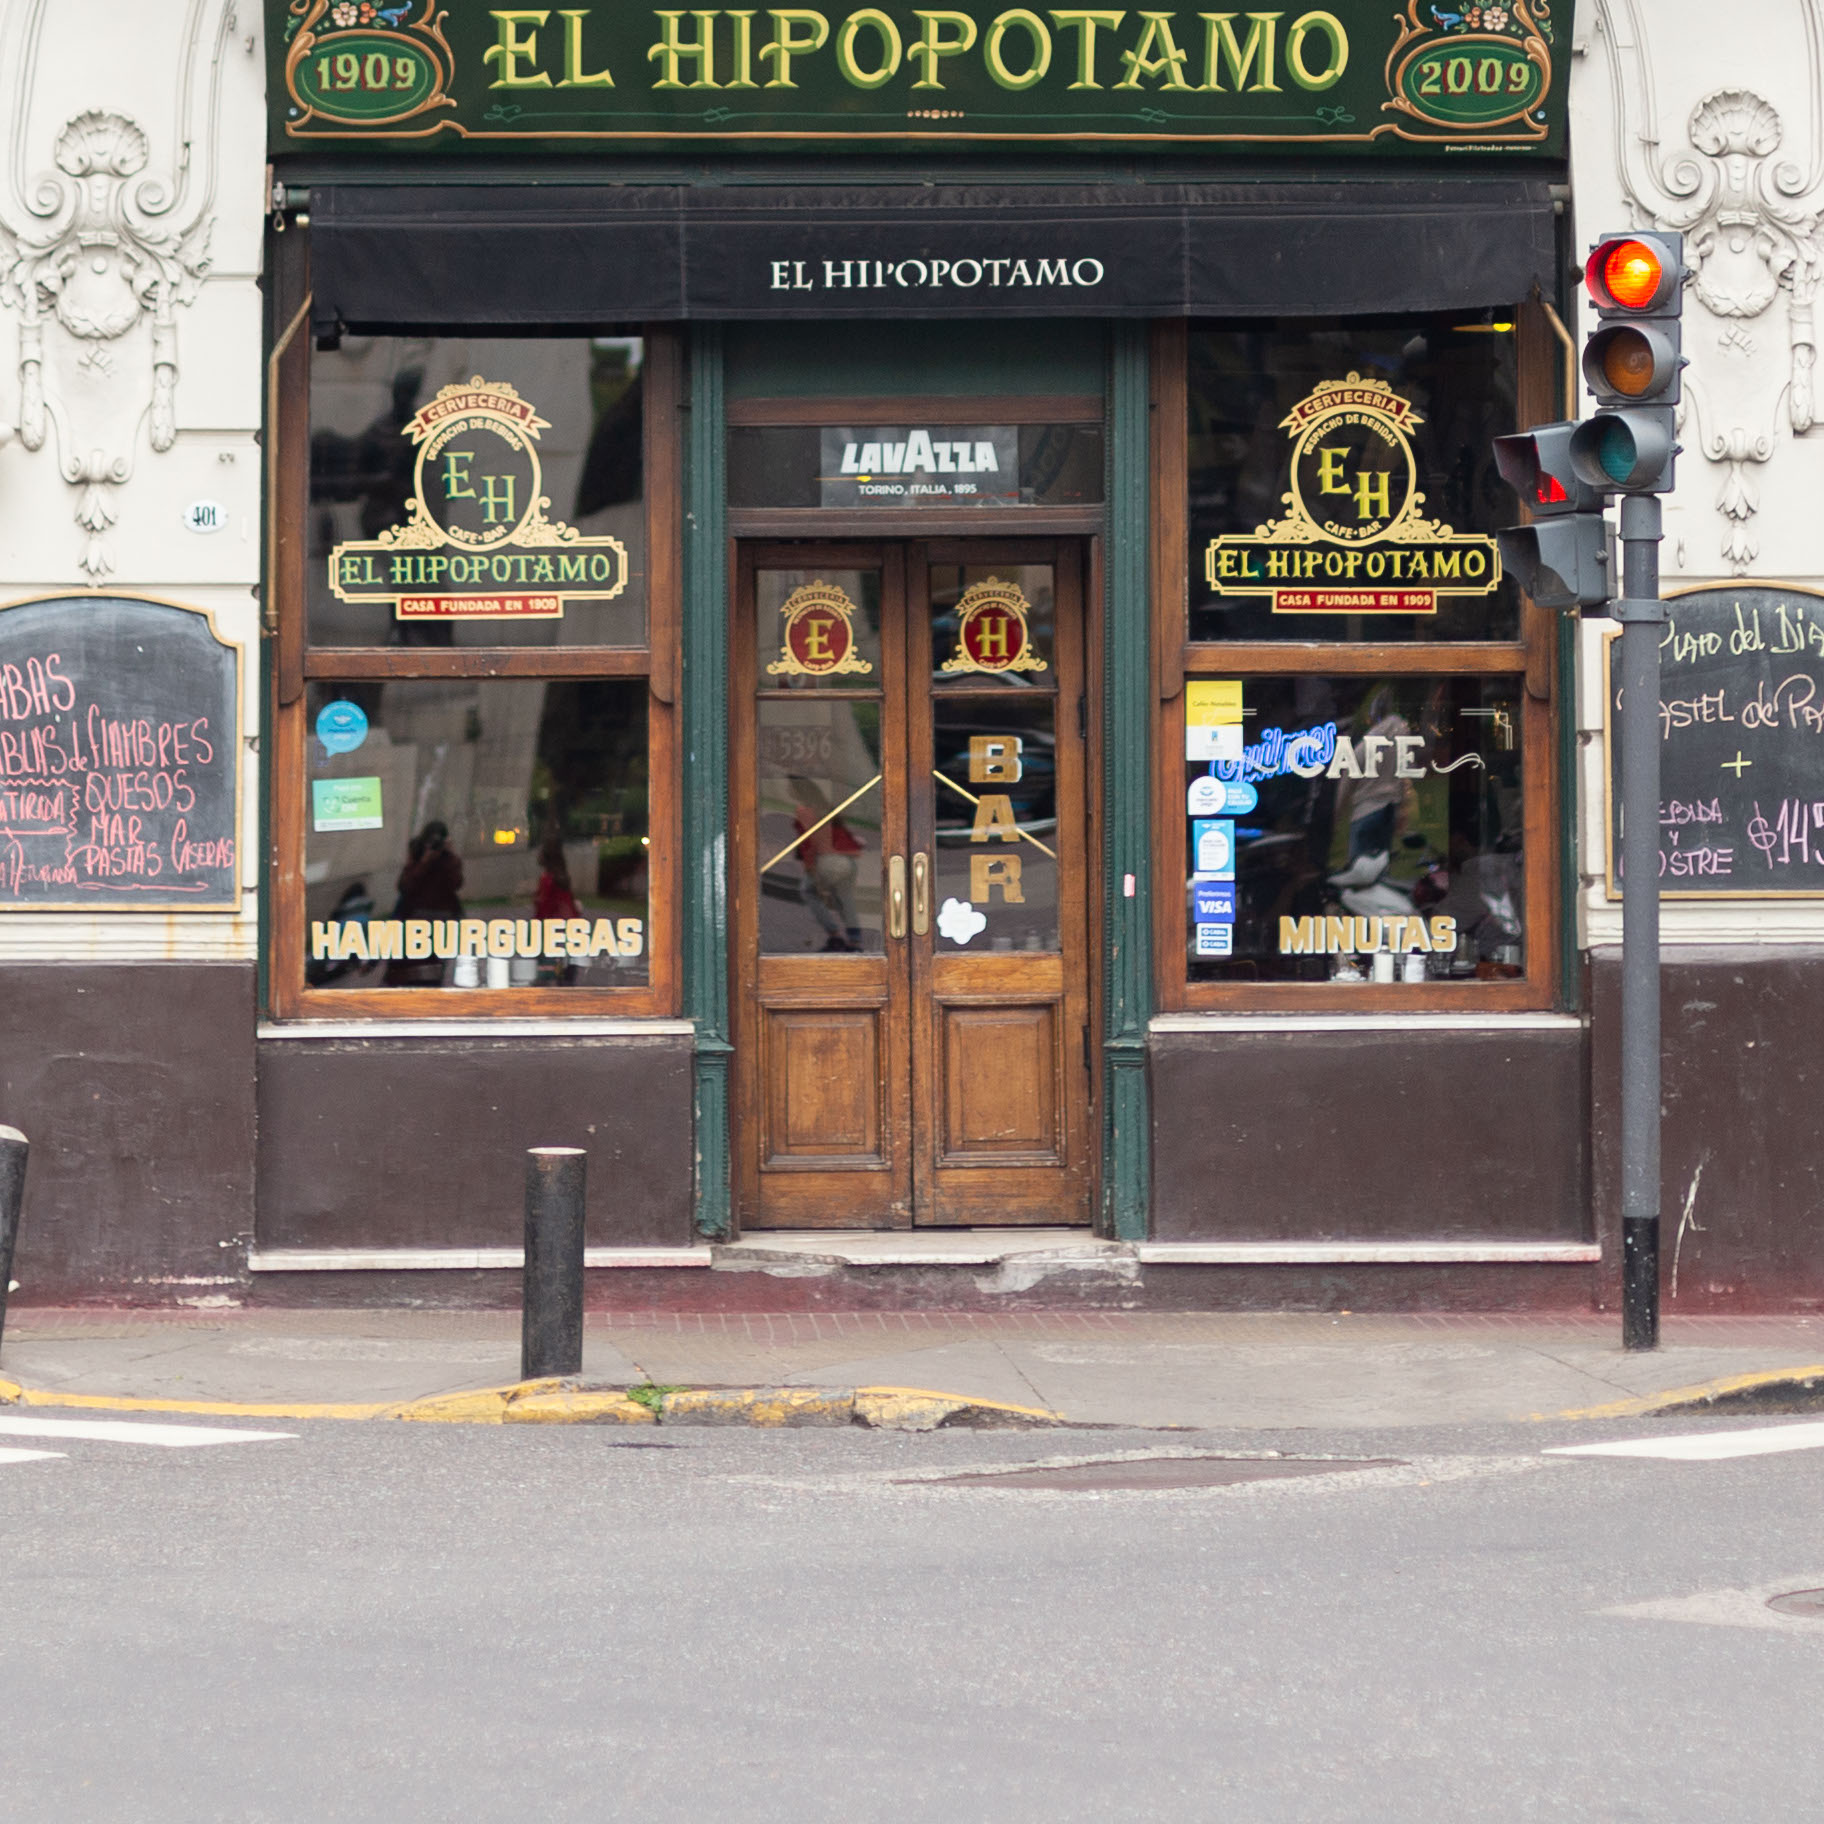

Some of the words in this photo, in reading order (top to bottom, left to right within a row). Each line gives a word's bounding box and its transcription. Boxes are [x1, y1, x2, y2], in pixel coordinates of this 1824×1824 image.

[483, 8, 616, 90] EL
[648, 7, 1349, 92] HIPOPOTAMO
[315, 49, 418, 94] 1909
[1418, 56, 1532, 98] 2009
[770, 260, 813, 291] EL
[823, 258, 1104, 288] HIPOPOTAMO
[427, 393, 524, 421] CERVECERIA
[1304, 390, 1398, 416] CERVECERIA
[426, 419, 468, 461] DESPACHO
[469, 417, 483, 430] DE
[483, 417, 524, 452] BEBIDAS
[840, 429, 999, 474] LAVAZZA
[1303, 415, 1343, 455] DESPACHO
[1345, 413, 1360, 425] DE
[1361, 415, 1399, 448] BEBIDAS
[954, 483, 977, 494] 1895
[192, 505, 217, 527] 401
[340, 555, 384, 584] EL
[389, 554, 610, 584] HIPOPOTAMO
[1217, 549, 1260, 578] EL
[1265, 549, 1486, 579] HIPOPOTAMO
[403, 598, 435, 612] CASA
[440, 598, 501, 612] FUNDADA
[505, 598, 523, 611] EN
[528, 597, 557, 611] 1909
[1279, 594, 1311, 606] CASA
[1316, 594, 1376, 606] FUNDADA
[1380, 594, 1398, 606] EN
[1403, 594, 1432, 606] 1909
[804, 619, 836, 660] E
[975, 616, 1009, 657] H
[1730, 602, 1765, 655] del
[87, 704, 213, 768] FIAMBRES
[1288, 735, 1427, 779] CAFE
[85, 769, 196, 821] QUESOS
[91, 814, 145, 847] MAR
[69, 843, 162, 876] PASTAS
[1198, 900, 1233, 914] VISA
[312, 918, 643, 960] HAMBURGUESAS
[1279, 915, 1456, 954] MINUTAS
